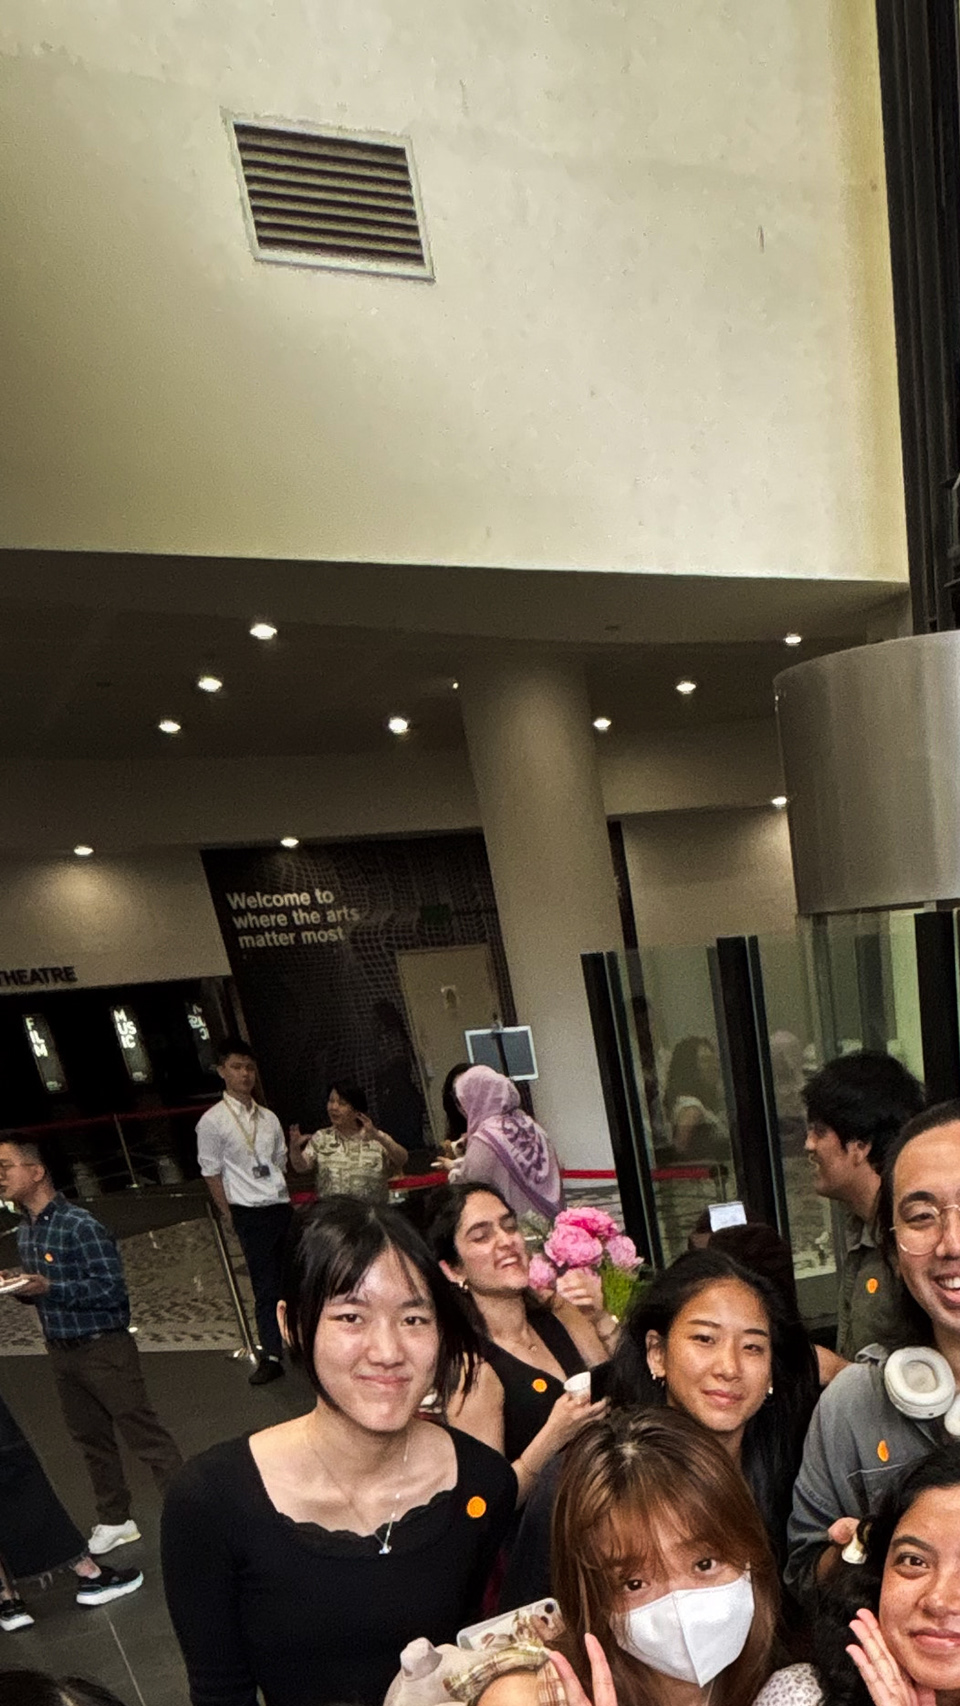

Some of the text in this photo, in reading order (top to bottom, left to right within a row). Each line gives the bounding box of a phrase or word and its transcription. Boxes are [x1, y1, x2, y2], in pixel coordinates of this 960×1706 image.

[226, 888, 335, 910] Welcome to
[232, 905, 360, 929] where the arts
[238, 926, 346, 949] matter most
